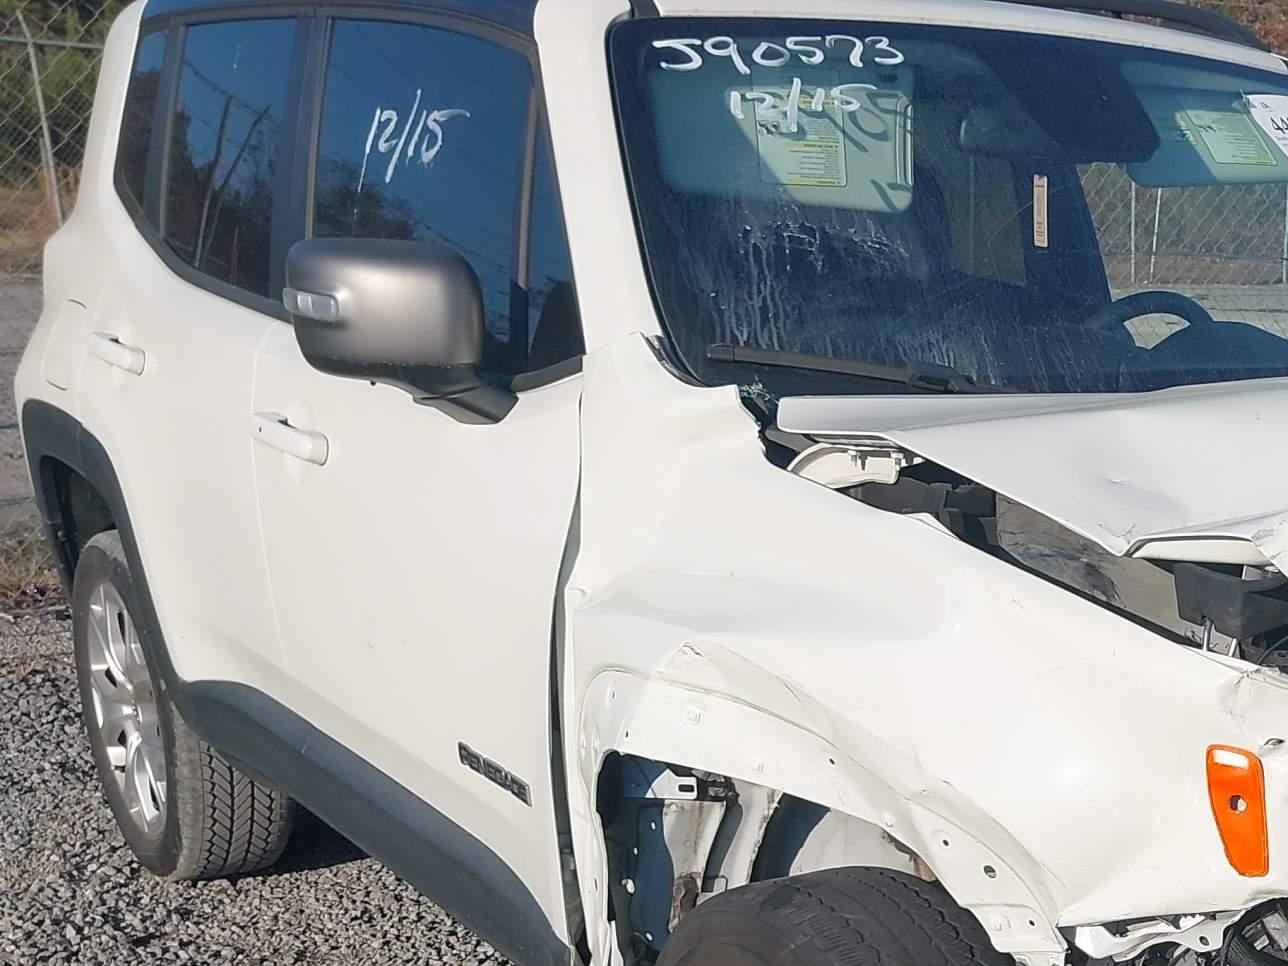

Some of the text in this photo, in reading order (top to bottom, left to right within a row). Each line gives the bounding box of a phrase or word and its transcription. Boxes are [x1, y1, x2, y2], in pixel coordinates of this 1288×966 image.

[651, 35, 905, 75] J90573
[729, 77, 878, 133] 12/15
[358, 88, 471, 185] 12/15
